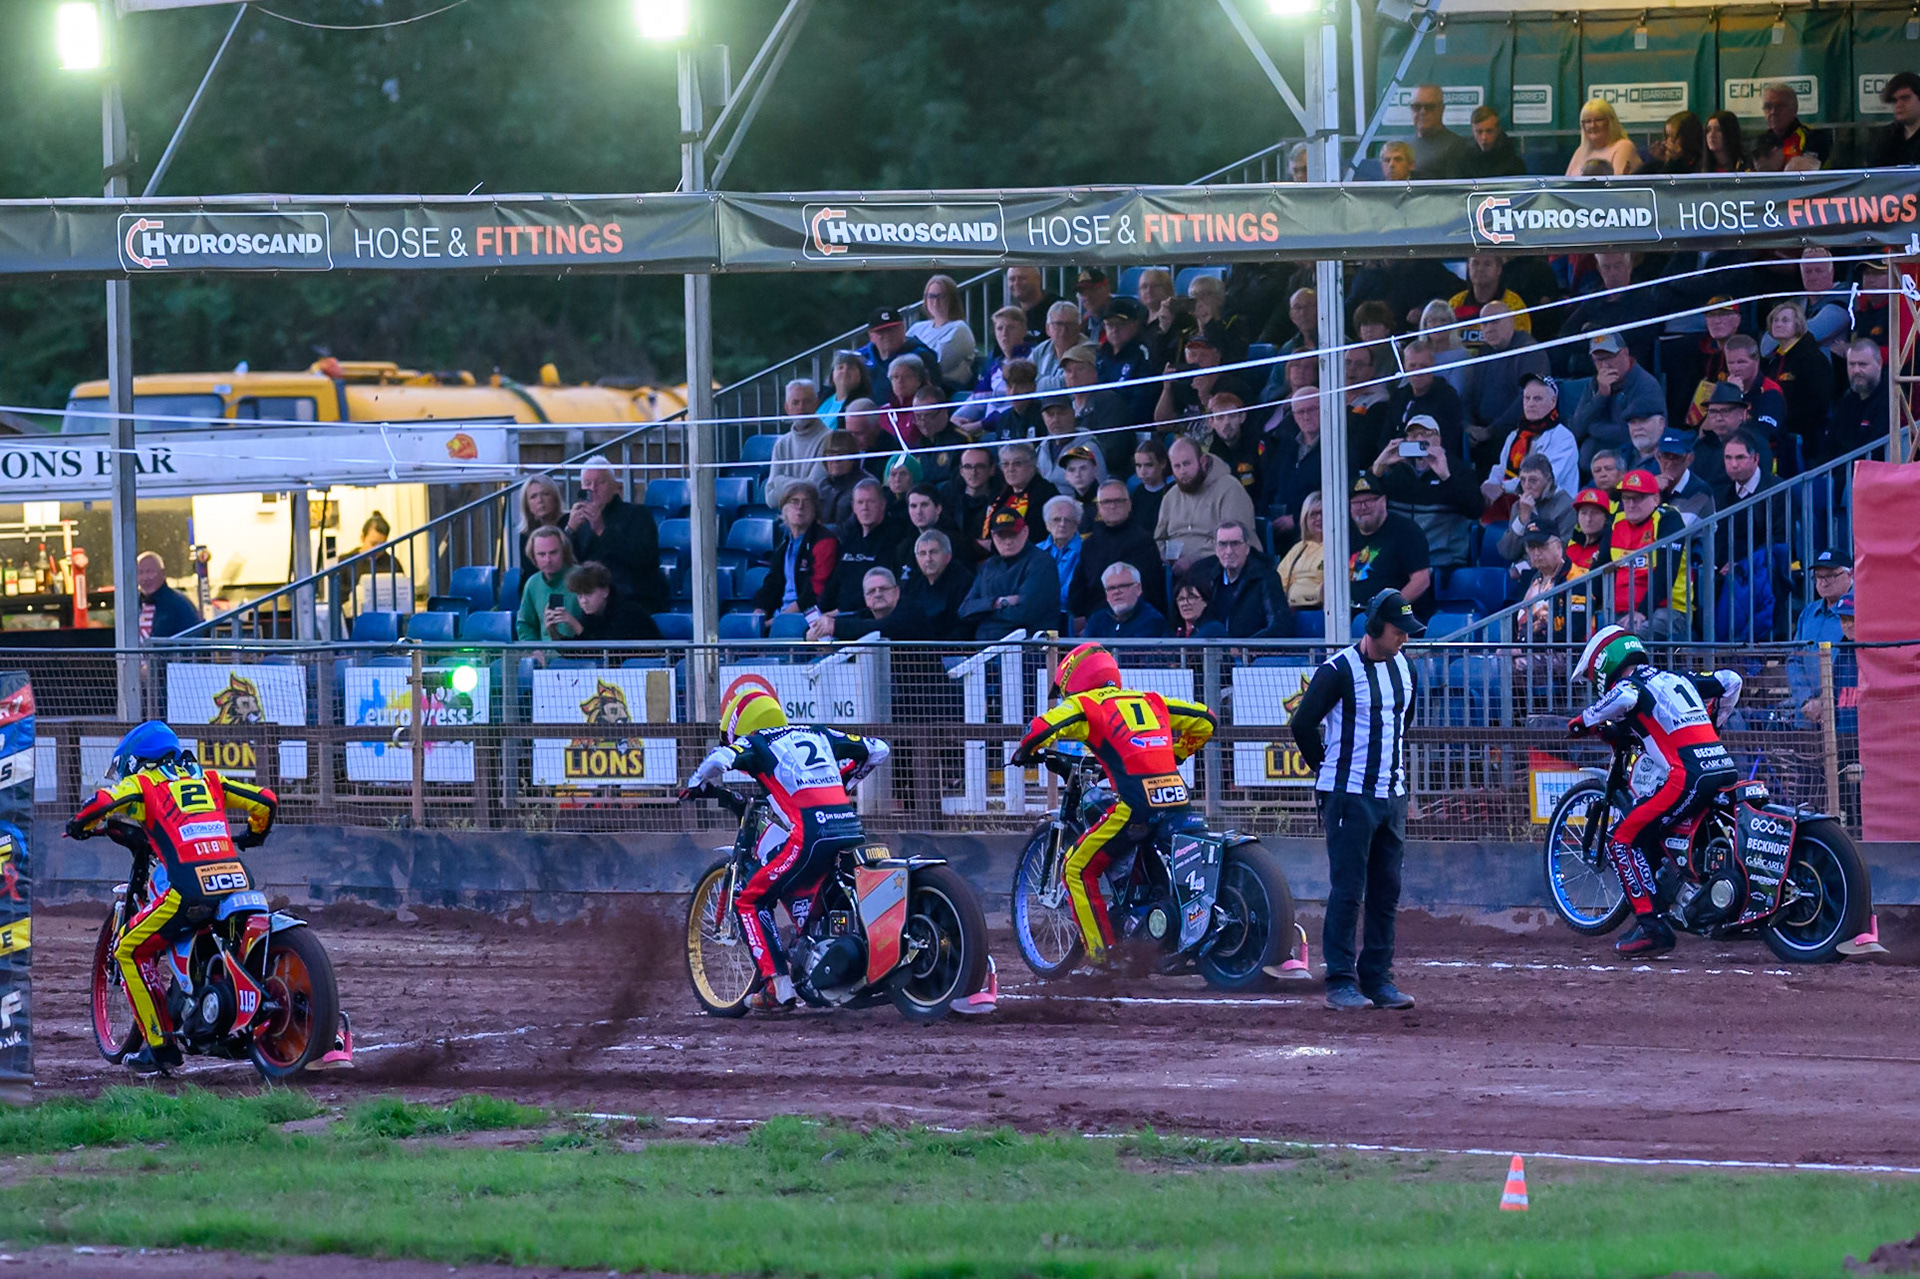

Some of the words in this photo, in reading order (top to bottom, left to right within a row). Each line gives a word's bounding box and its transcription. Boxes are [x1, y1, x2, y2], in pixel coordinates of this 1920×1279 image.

[1513, 90, 1547, 102] ARRIER
[1592, 87, 1639, 103] ECHO
[1641, 88, 1683, 100] BARRIER
[1492, 208, 1653, 232] HYDROSCAND
[1678, 200, 1757, 231] HOSE
[1763, 200, 1784, 228] &
[1788, 194, 1918, 226] FITTINGS
[354, 226, 440, 258] HOSE
[447, 227, 468, 257] &
[477, 223, 624, 256] FITTINGS
[827, 220, 998, 244] HYDROSCAND
[1027, 214, 1111, 246] HOSE
[1117, 215, 1137, 244] &
[1144, 212, 1279, 243] FITTINGS
[142, 232, 323, 257] HYDROSCAND
[95, 445, 178, 477] BR
[1673, 683, 1698, 708] 1
[1130, 703, 1146, 725] 1
[566, 749, 642, 776] LIONS
[794, 740, 827, 767] 2
[1266, 749, 1312, 776] LIO
[180, 784, 208, 808] 2
[1151, 786, 1186, 804] JCB
[1746, 837, 1789, 856] BECKHOFF
[204, 873, 247, 891] JCB
[239, 990, 256, 1012] 118
